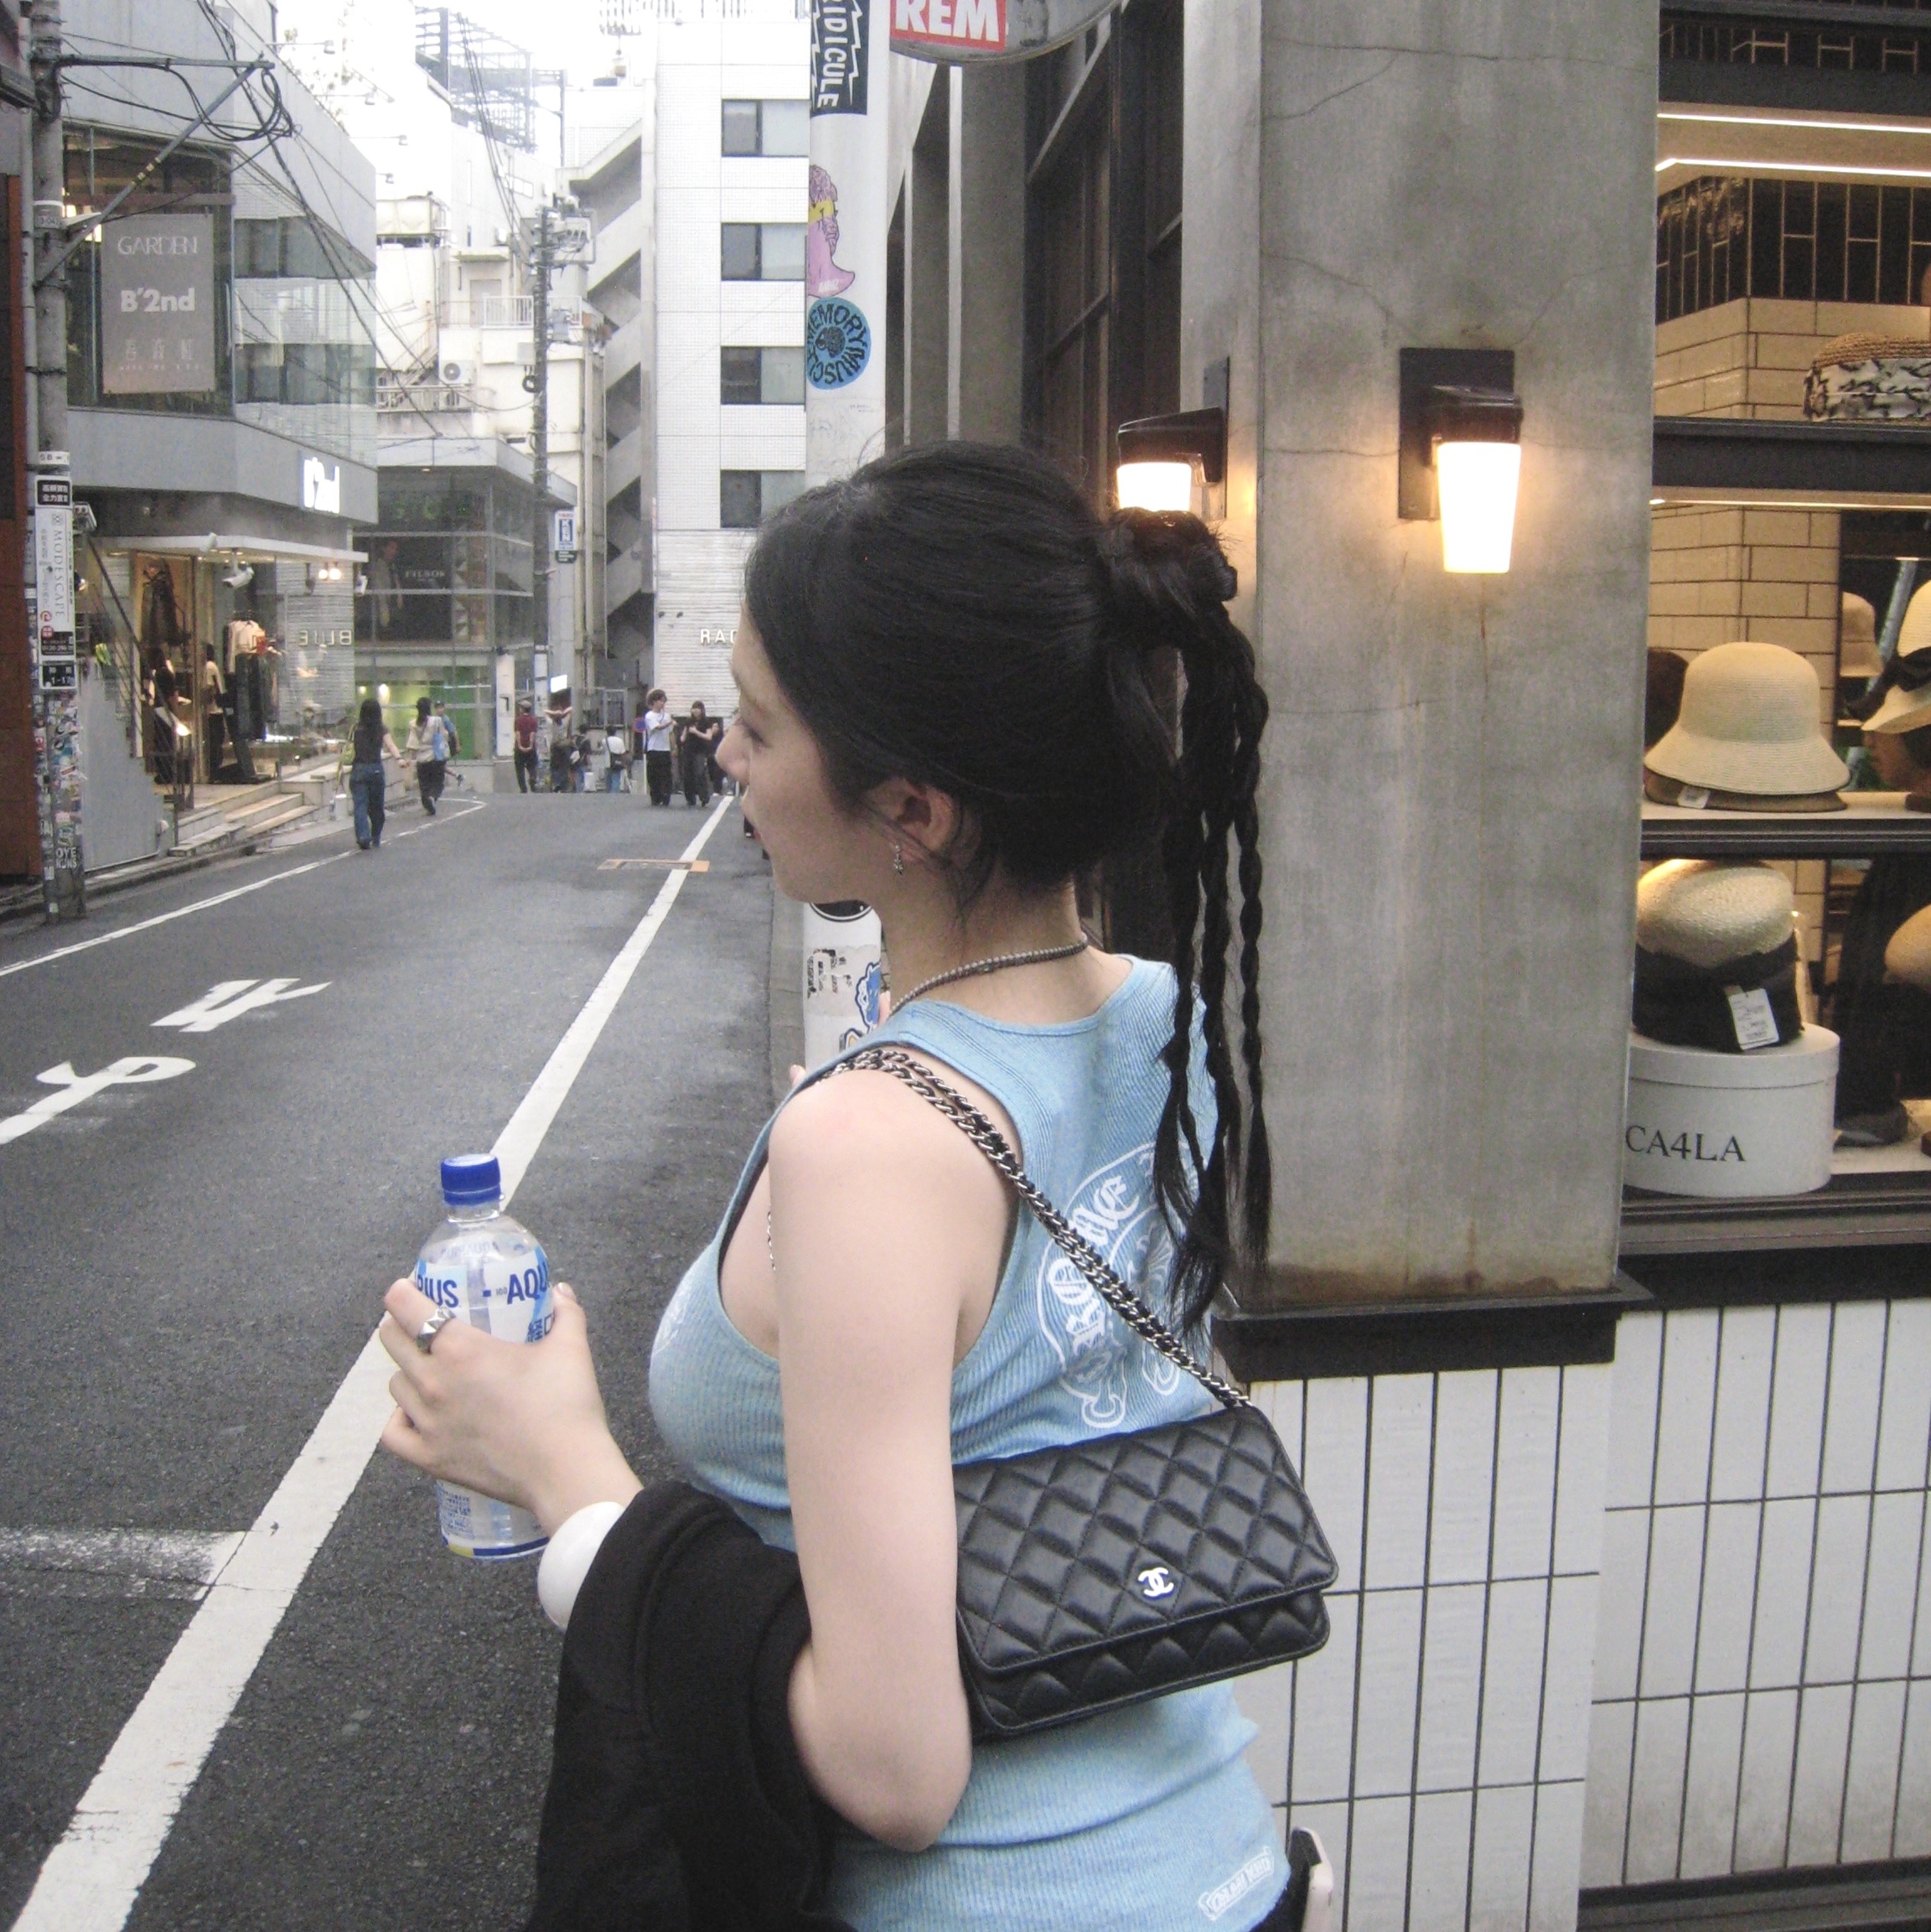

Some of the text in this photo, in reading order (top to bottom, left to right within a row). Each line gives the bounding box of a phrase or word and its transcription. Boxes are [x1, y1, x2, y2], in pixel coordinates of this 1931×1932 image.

[895, 0, 1000, 43] REM
[818, 0, 848, 108] IDICULE
[1625, 1124, 1747, 1162] CA4LA
